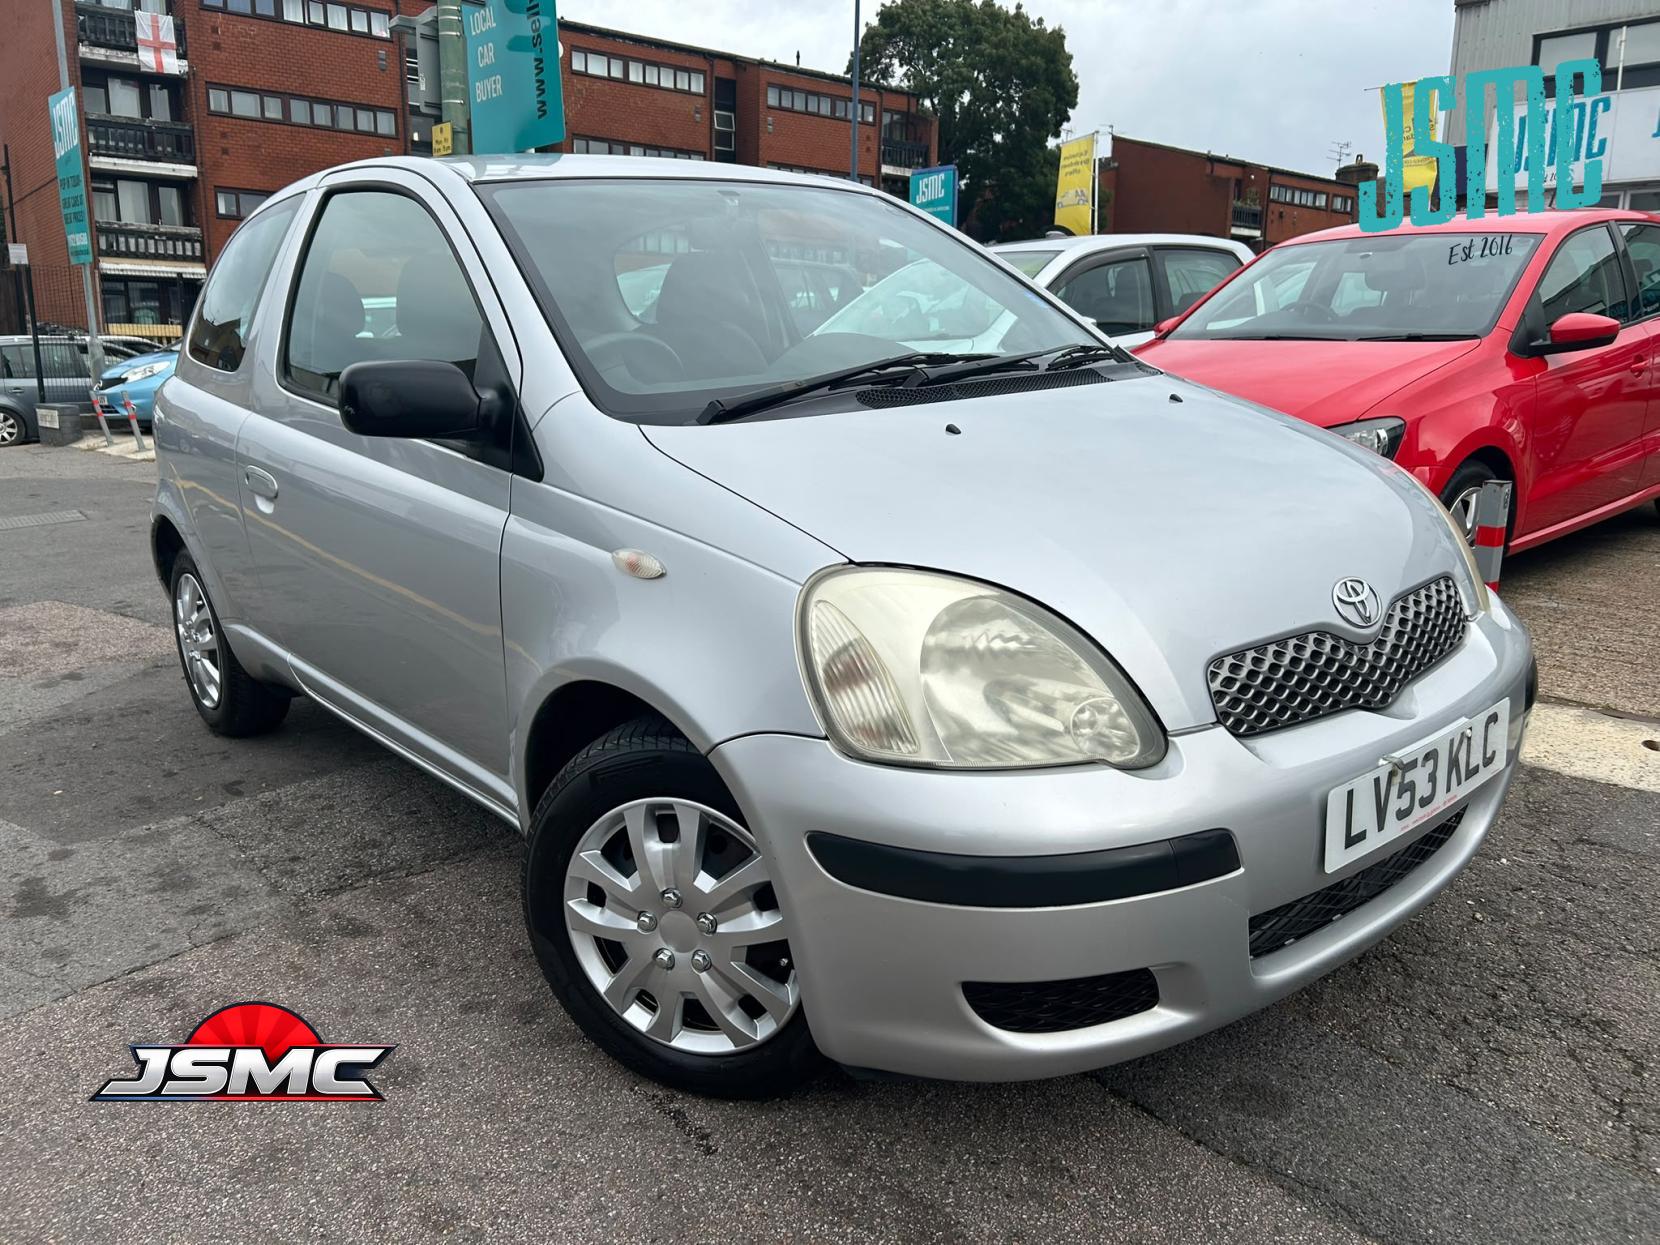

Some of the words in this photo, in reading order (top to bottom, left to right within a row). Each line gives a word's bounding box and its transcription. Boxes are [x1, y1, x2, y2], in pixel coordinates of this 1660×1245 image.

[470, 8, 496, 35] LOCAL
[477, 43, 495, 67] CAR
[526, 0, 548, 119] www.sell
[475, 75, 503, 102] BUYER
[53, 91, 79, 159] JSMC
[916, 173, 945, 204] JSMC
[1344, 748, 1438, 850] LV53
[1446, 712, 1498, 794] KLC
